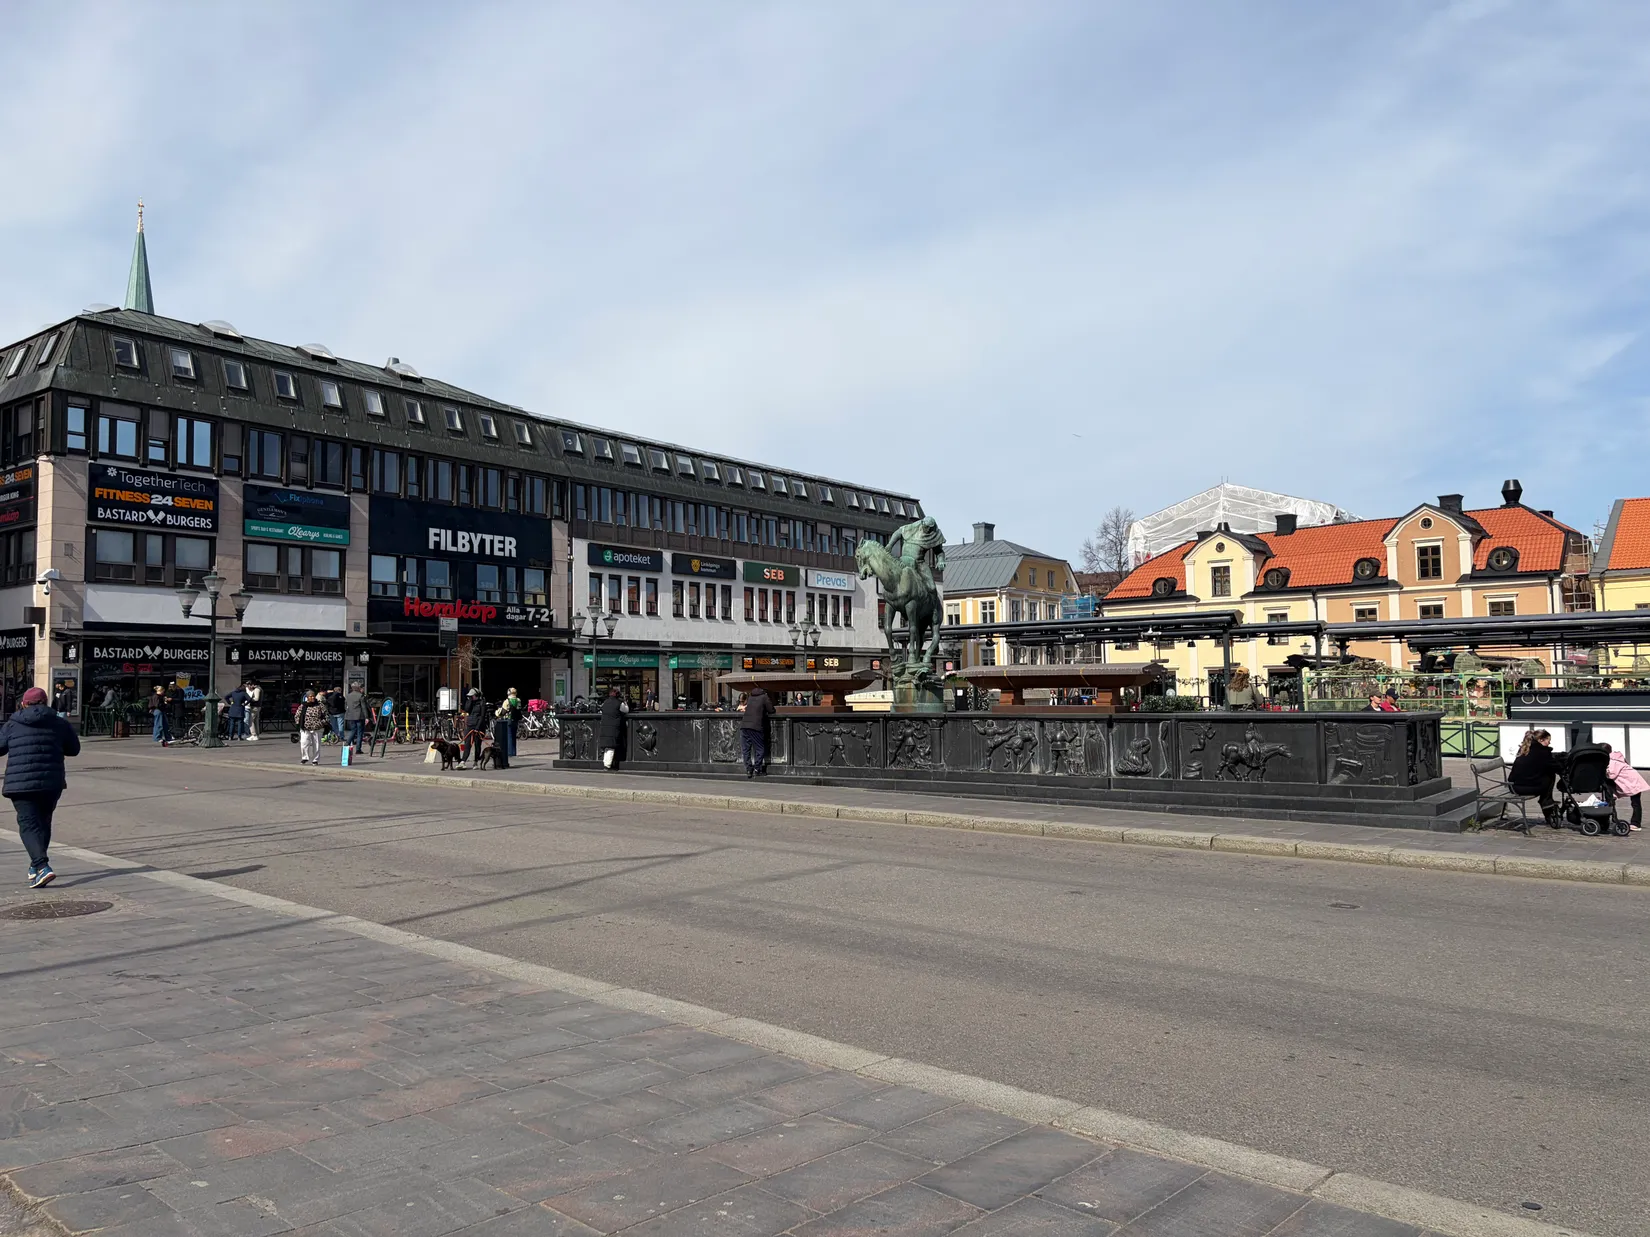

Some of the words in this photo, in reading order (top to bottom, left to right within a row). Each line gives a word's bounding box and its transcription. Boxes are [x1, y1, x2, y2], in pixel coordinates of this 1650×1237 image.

[97, 507, 147, 522] BASTARD
[166, 514, 212, 529] BURGERS
[288, 525, 320, 540] O'Learys
[428, 527, 517, 558] FILBYTER
[613, 552, 651, 565] apoteket
[763, 568, 784, 581] SEB
[816, 573, 847, 587] Prevas
[404, 596, 497, 623] Hemköp
[526, 607, 557, 622] 7-21
[506, 613, 526, 621] dagar
[6, 636, 28, 649] BURGERS
[93, 647, 143, 659] BASTARD
[163, 648, 209, 660] BURGERS
[248, 650, 290, 660] BASTARD
[305, 651, 343, 661] BURGERS
[823, 657, 840, 667] SEB
